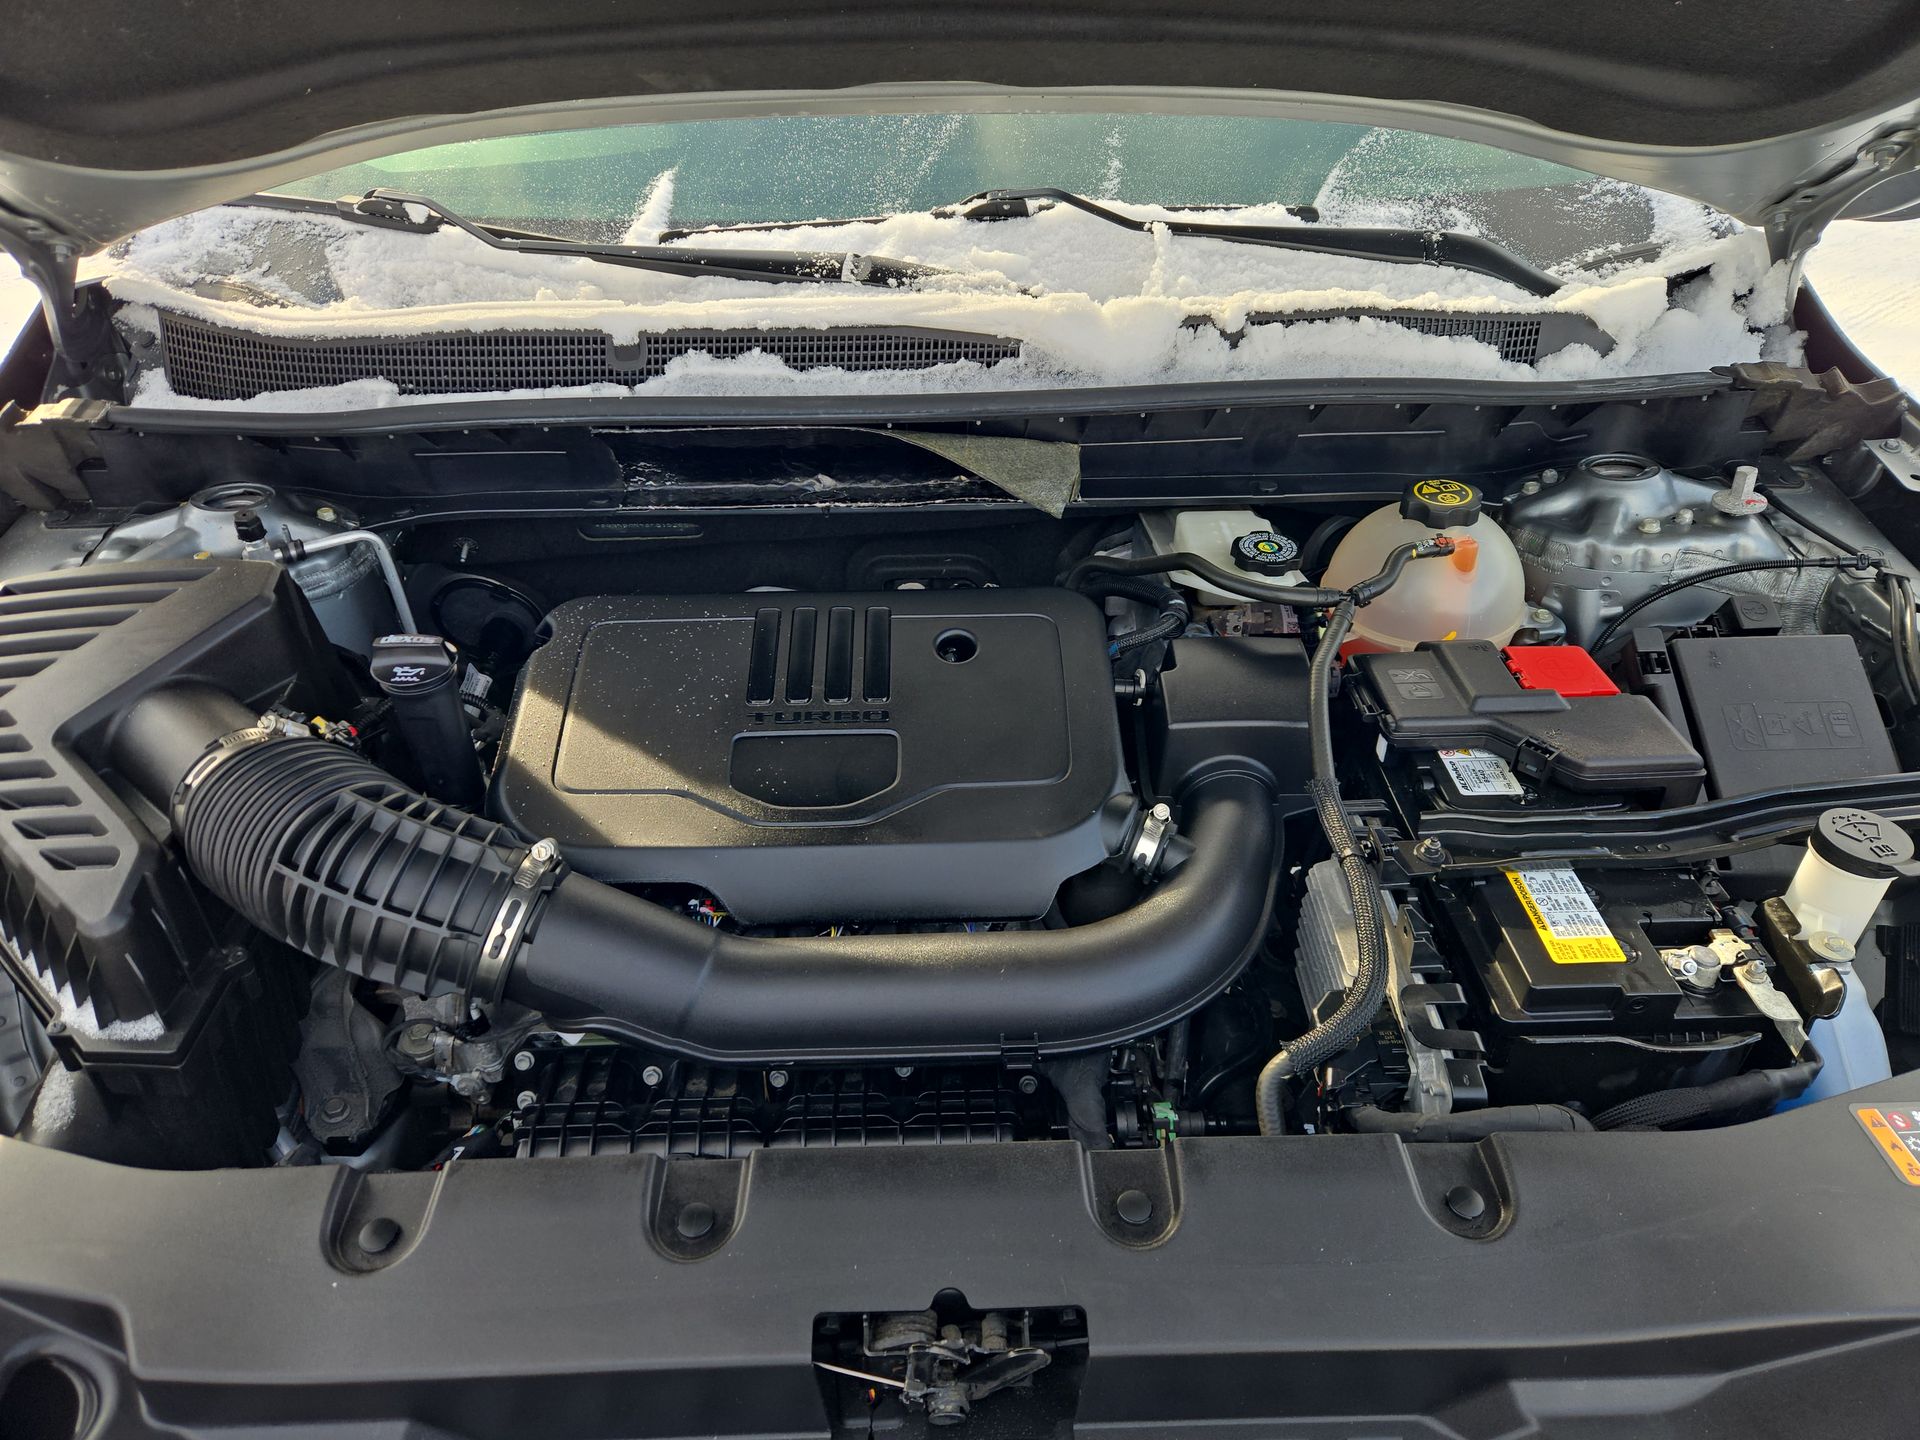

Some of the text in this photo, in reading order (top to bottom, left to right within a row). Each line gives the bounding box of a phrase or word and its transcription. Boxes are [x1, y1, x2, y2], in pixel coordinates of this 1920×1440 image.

[380, 635, 437, 643] dexos
[746, 710, 889, 724] TURBO
[1449, 761, 1470, 791] ACDelco
